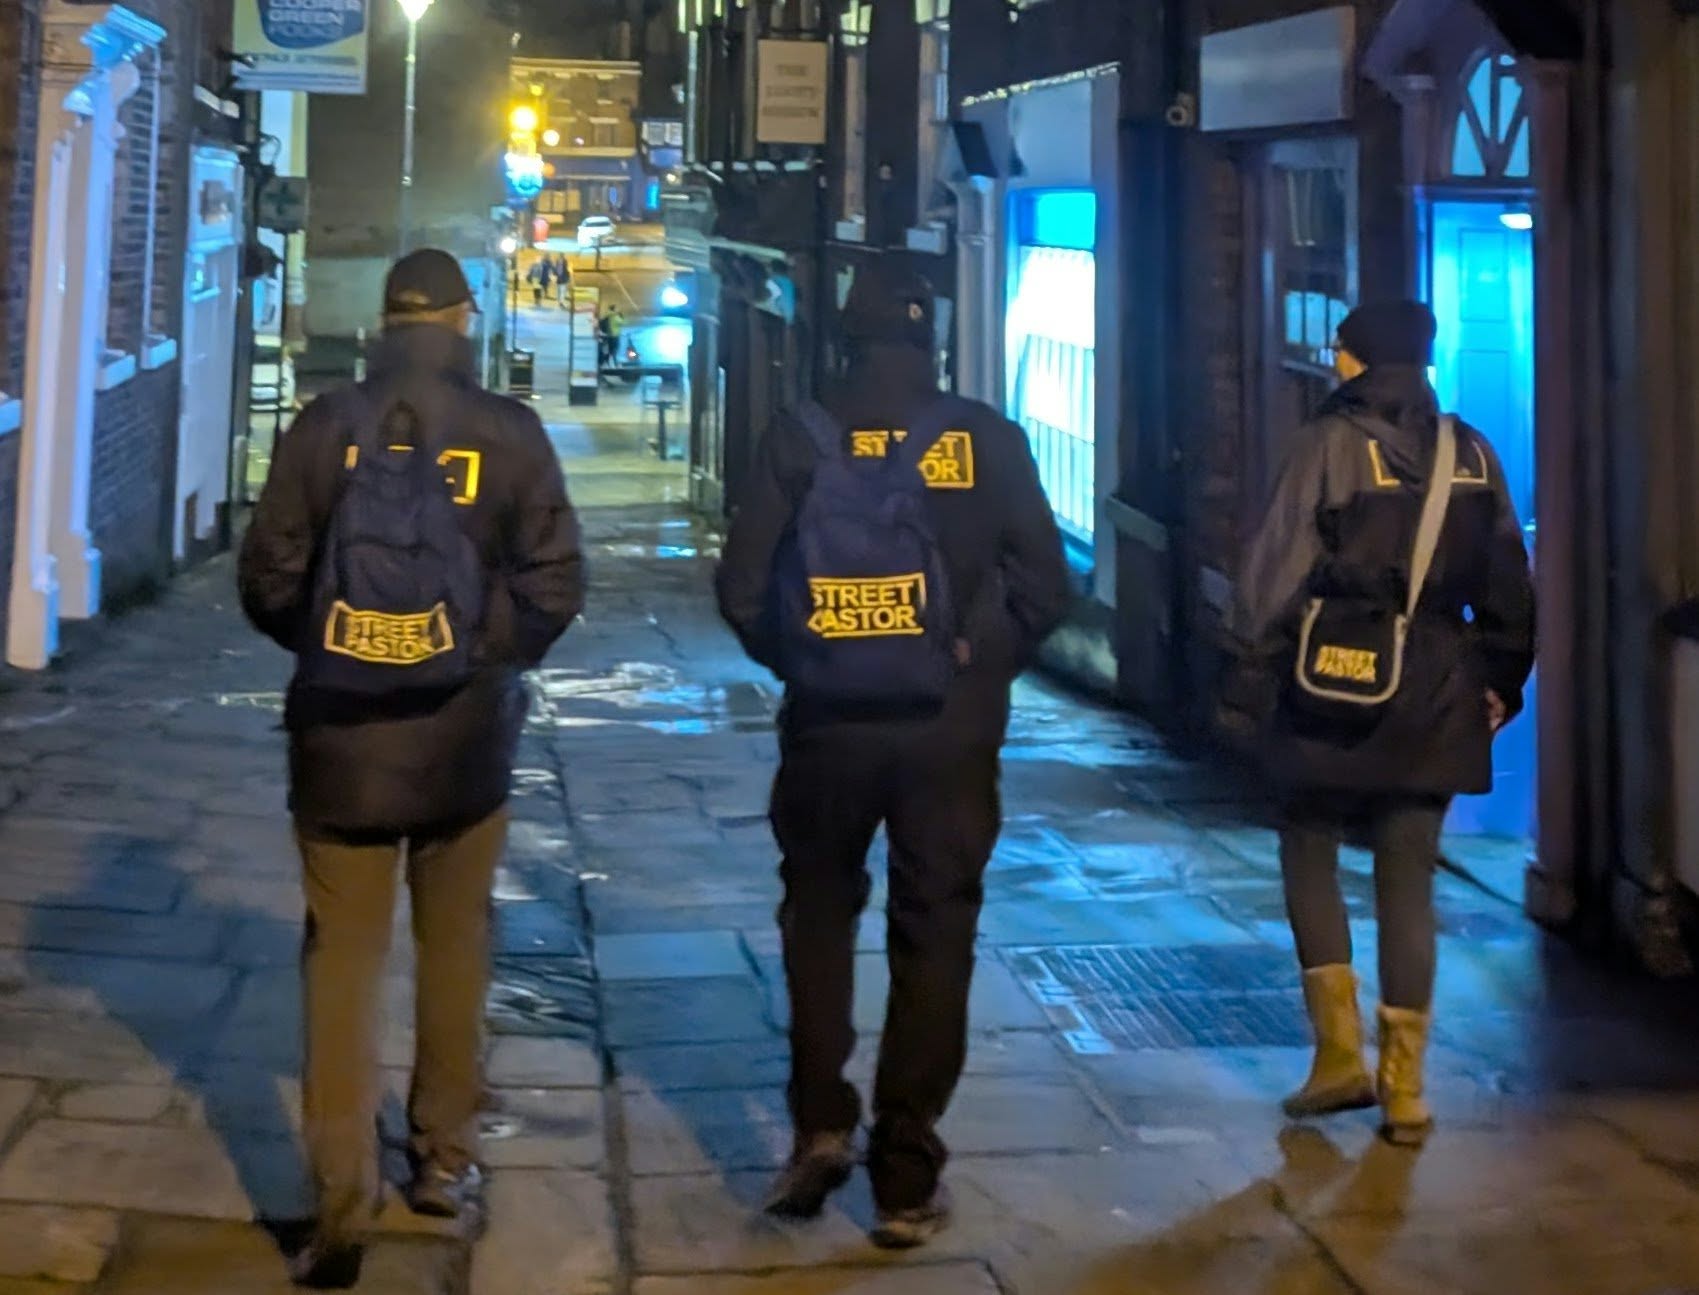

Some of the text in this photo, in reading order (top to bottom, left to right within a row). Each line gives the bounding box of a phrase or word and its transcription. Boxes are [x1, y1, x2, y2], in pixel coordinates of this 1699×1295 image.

[269, 9, 344, 25] GREEN
[811, 581, 914, 607] STREET
[346, 615, 429, 640] STREET
